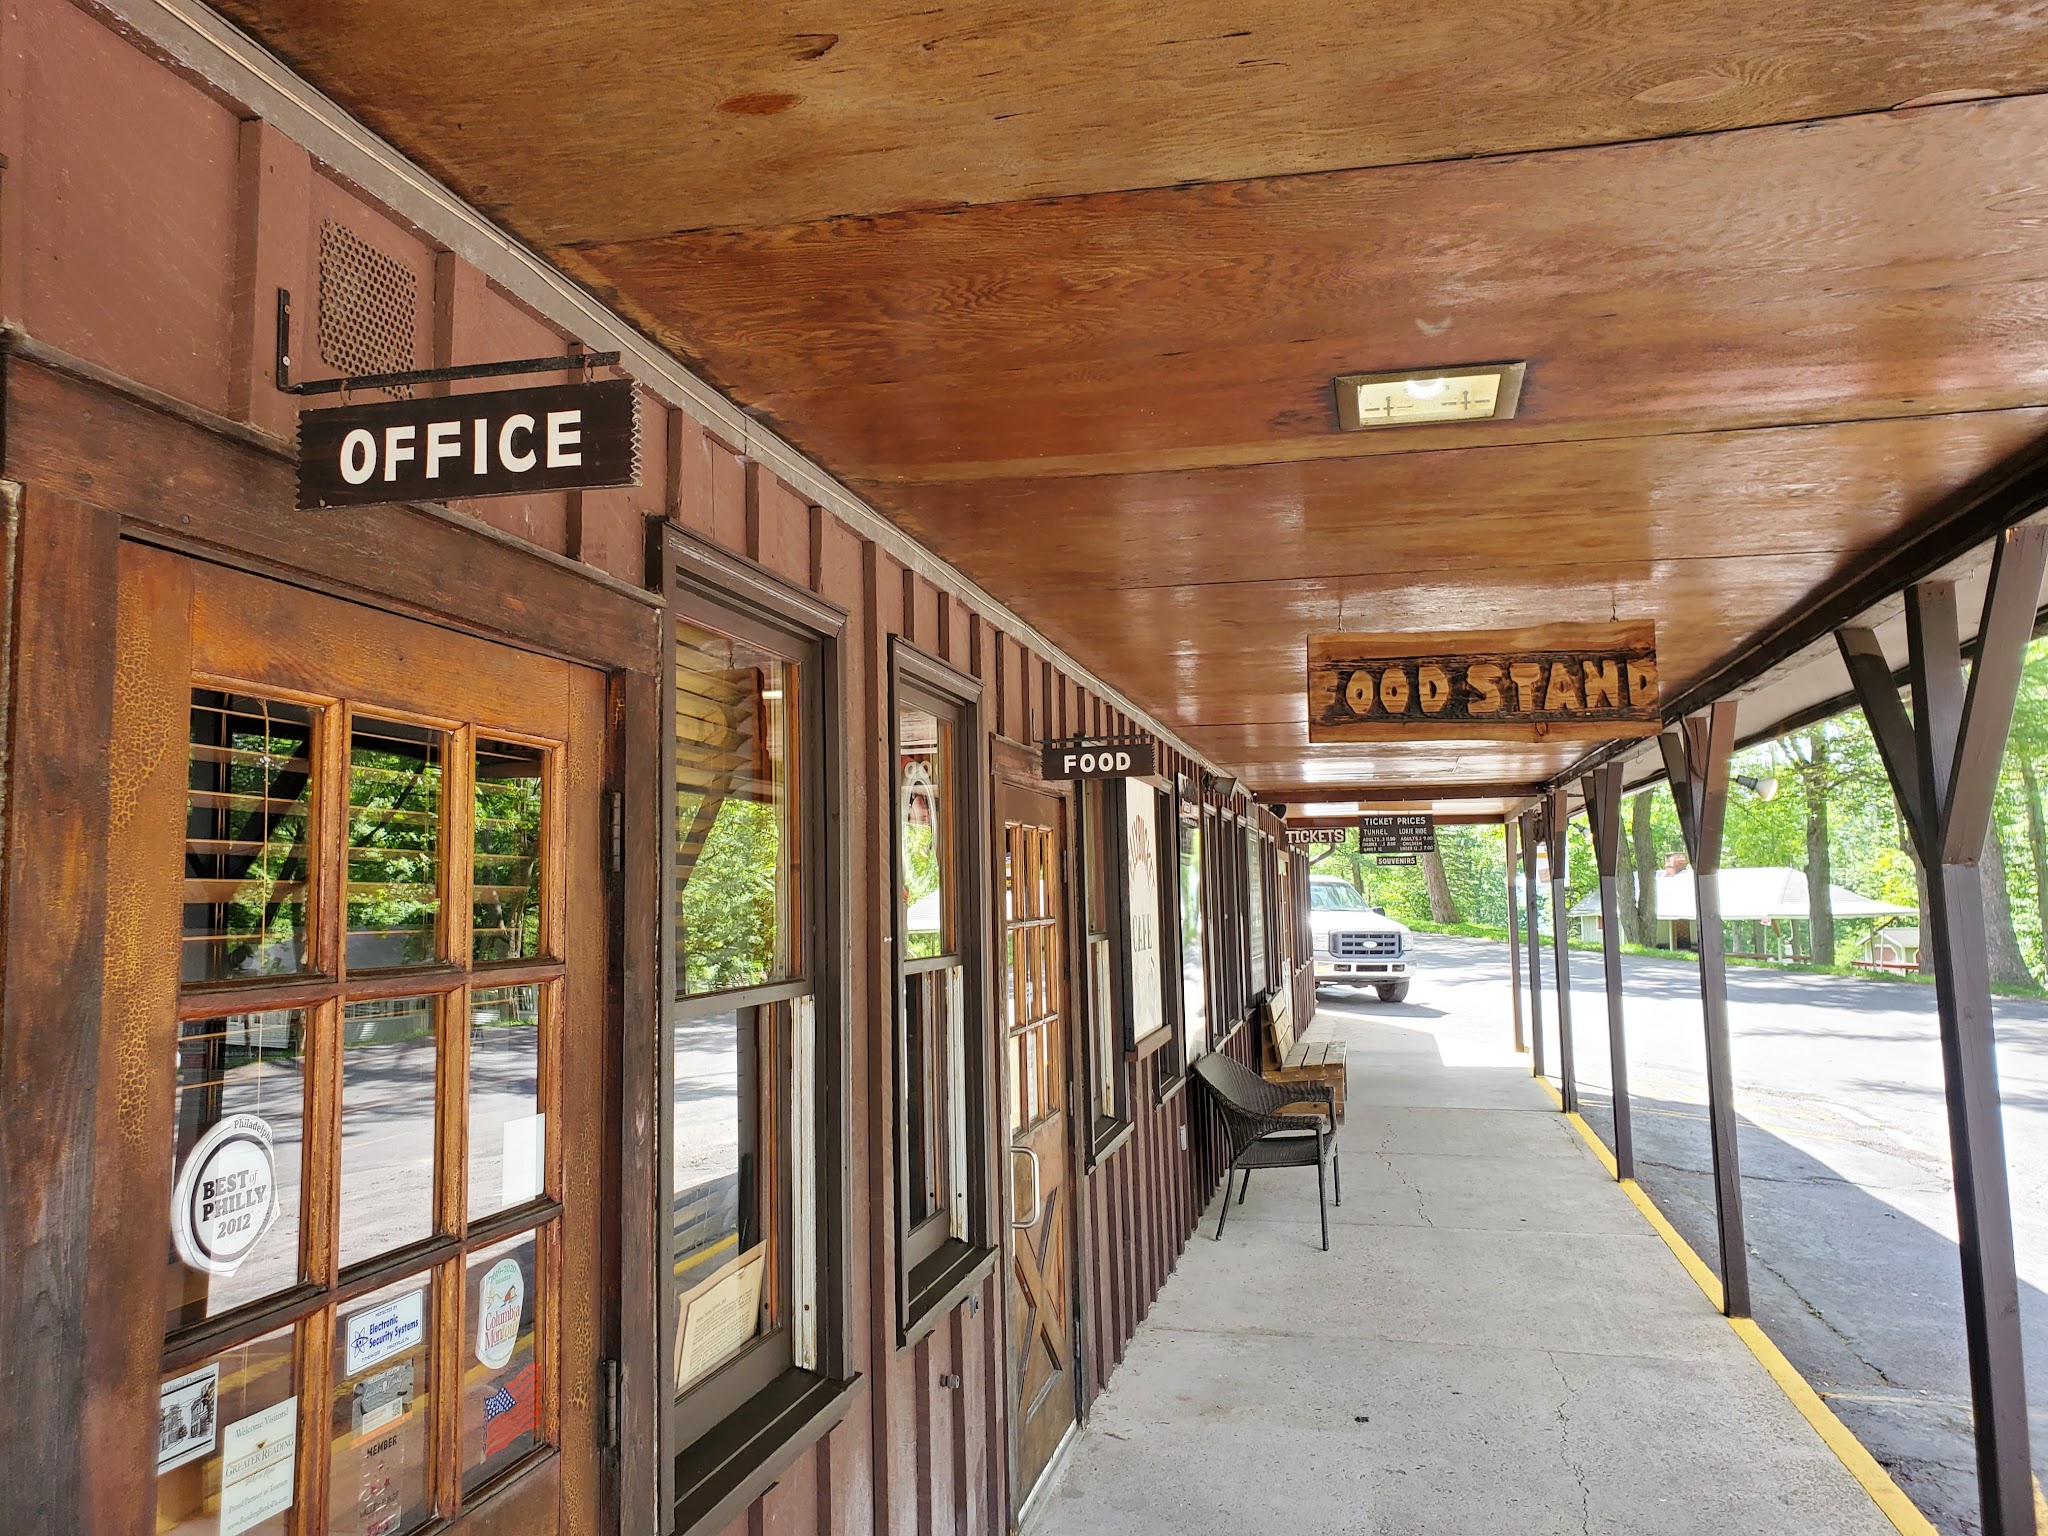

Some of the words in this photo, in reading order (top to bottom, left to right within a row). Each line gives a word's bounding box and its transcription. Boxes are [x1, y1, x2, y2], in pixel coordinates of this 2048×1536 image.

[339, 409, 583, 485] OFFICE
[1309, 663, 1451, 716] FOOD
[1466, 656, 1660, 717] STAND
[1063, 752, 1131, 774] FOOD
[1364, 817, 1394, 825] TICKET
[1397, 816, 1426, 825] PRICES
[1285, 829, 1345, 844] TICKETS
[1378, 857, 1416, 865] SOUVENIRS
[1132, 913, 1152, 953] CAFE
[202, 1169, 249, 1201] BEST
[249, 1169, 259, 1186] of
[202, 1184, 267, 1222] PHILLY
[216, 1213, 251, 1240] 2012
[369, 1313, 399, 1335] Electronic
[485, 1304, 520, 1332] Columbia
[369, 1330, 393, 1349] Security
[394, 1319, 419, 1338] Systems
[235, 1421, 264, 1438] Welcome
[264, 1406, 289, 1425] Visitors!
[225, 1453, 261, 1478] GREATER
[261, 1439, 294, 1461] READING
[366, 1434, 398, 1460] MEMBER
